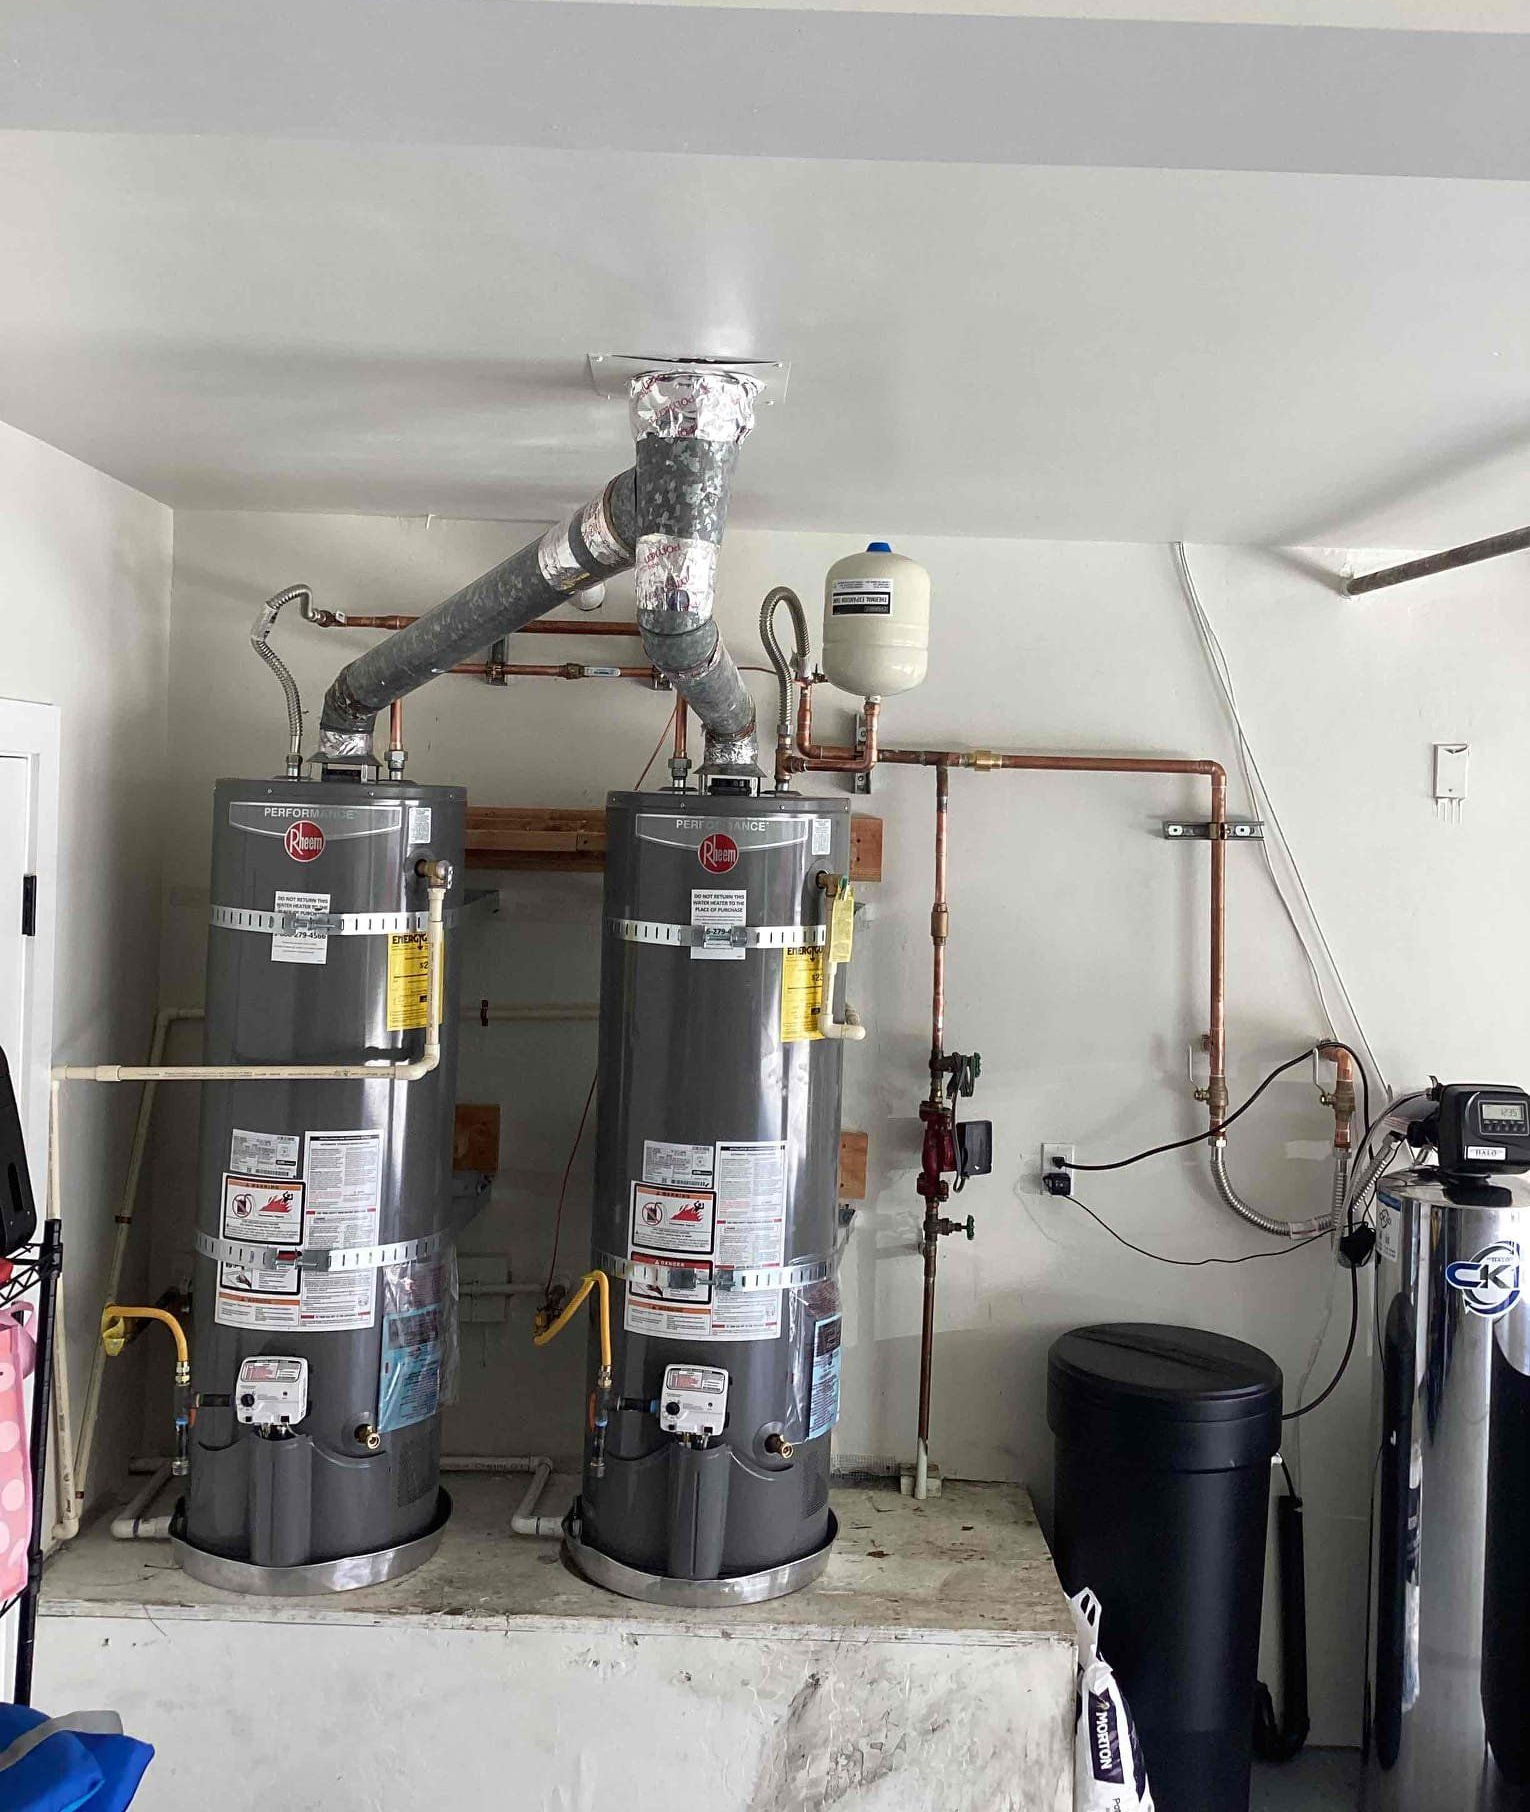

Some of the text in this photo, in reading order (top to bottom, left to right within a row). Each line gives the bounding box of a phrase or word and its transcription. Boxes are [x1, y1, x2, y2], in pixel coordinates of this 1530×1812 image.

[290, 823, 322, 856] Rheem
[703, 835, 736, 868] Rheem
[1475, 1148, 1497, 1157] HALO
[1096, 1711, 1113, 1770] MORTON
